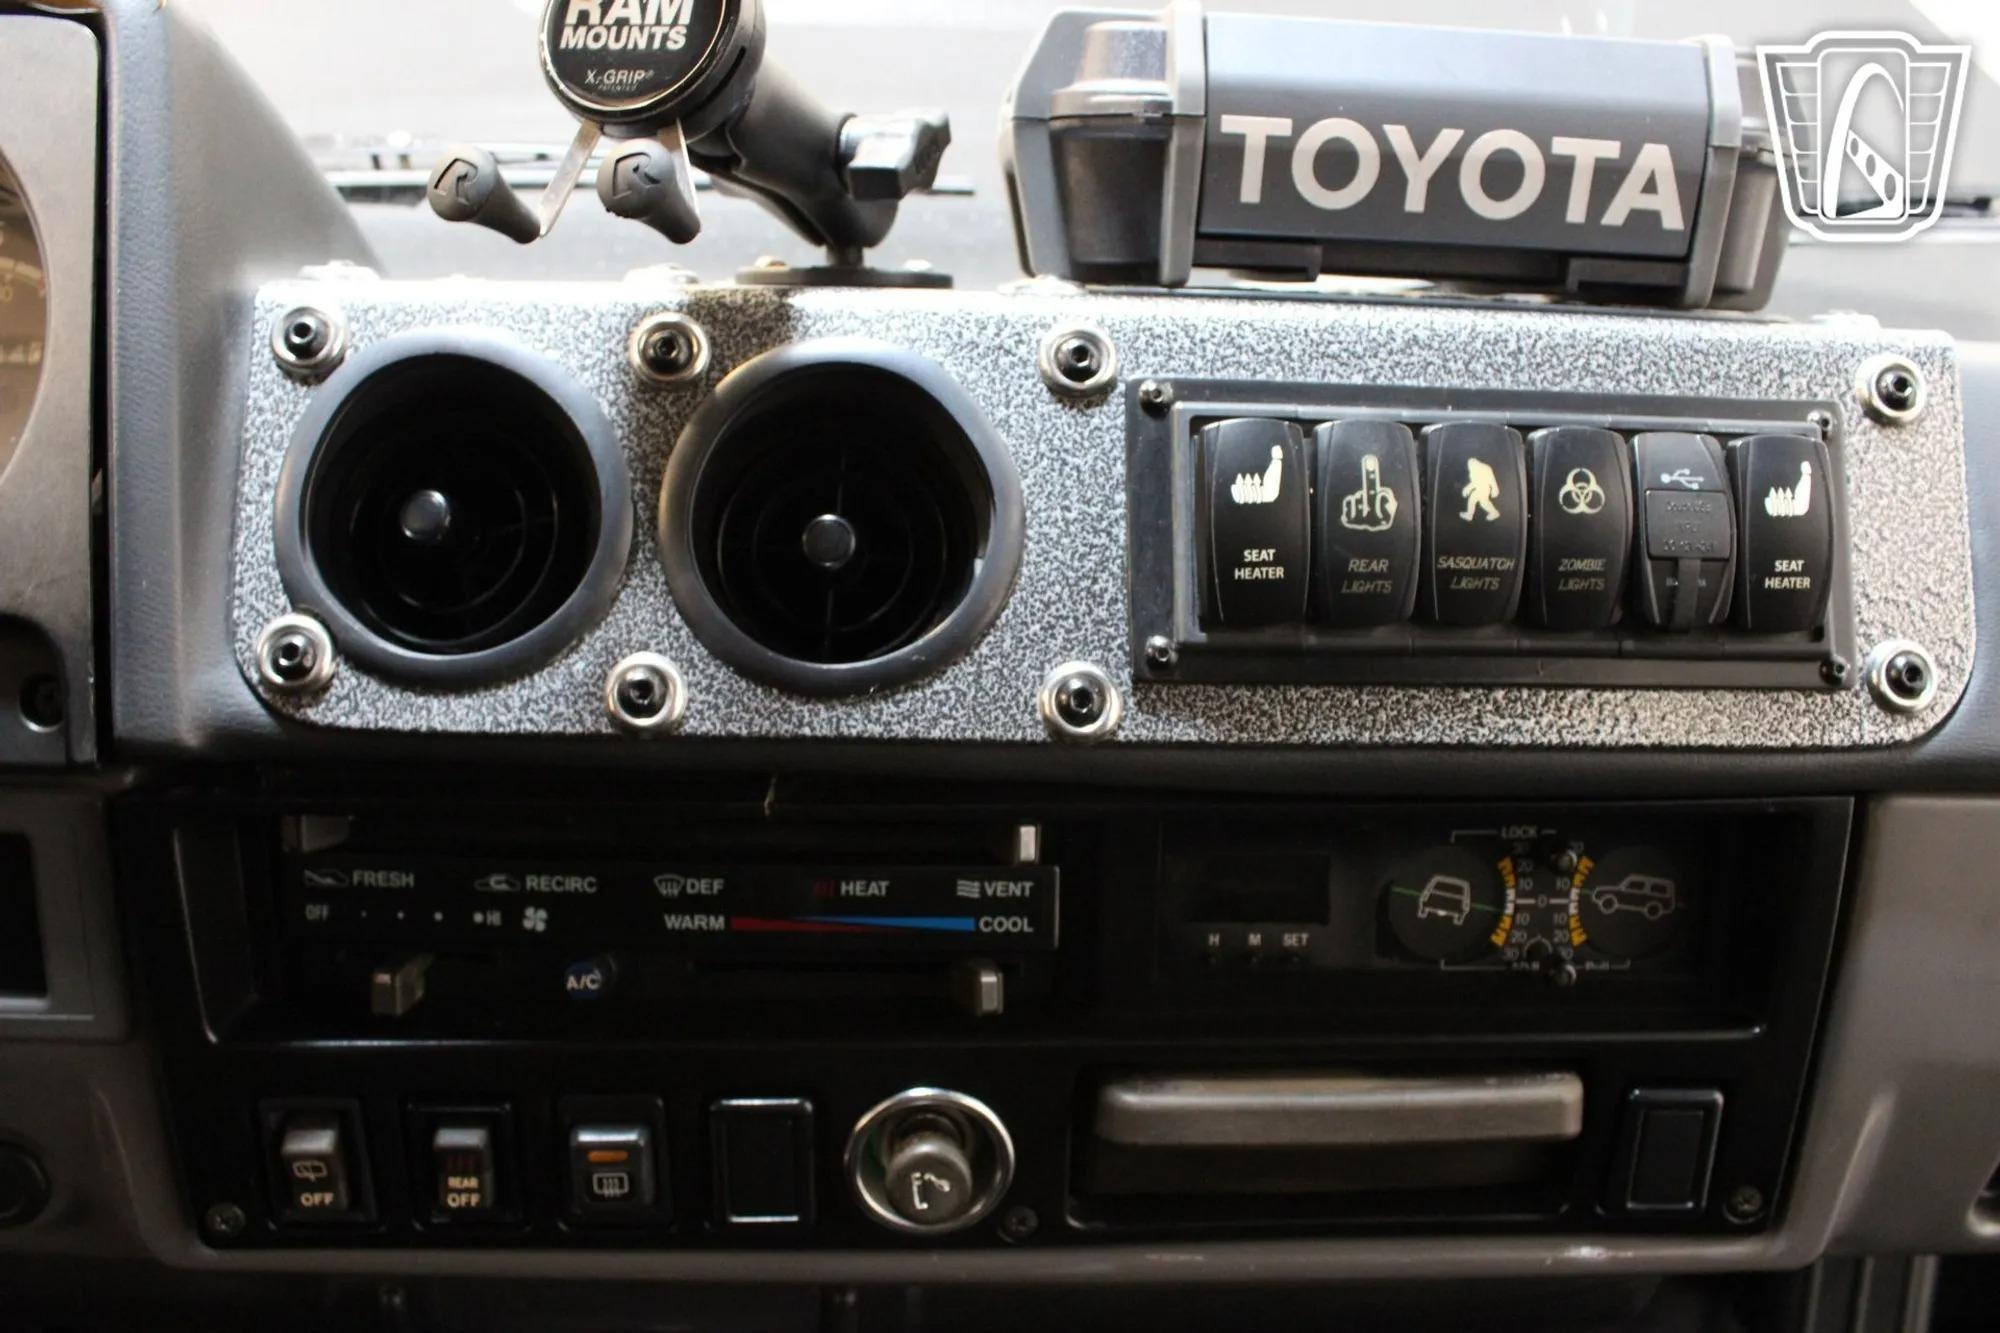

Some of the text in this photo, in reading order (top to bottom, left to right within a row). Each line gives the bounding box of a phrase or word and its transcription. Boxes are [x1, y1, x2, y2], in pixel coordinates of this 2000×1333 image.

[564, 0, 694, 25] RAM
[560, 25, 688, 50] MOUNTS
[1220, 114, 1685, 233] TOYOTA
[1243, 549, 1276, 562] SEAT
[1348, 558, 1389, 573] REAR
[1436, 556, 1516, 571] SASQUATCH
[1558, 558, 1607, 572] ZOMBIE
[1774, 560, 1805, 572] SEAT
[1234, 566, 1285, 580] HEATER
[1340, 580, 1393, 594] LIGHTS
[1450, 576, 1501, 591] LIGHTS
[1557, 577, 1606, 591] LIGHTS
[1764, 576, 1811, 589] HEATER
[1501, 825, 1538, 839] LOCK
[352, 869, 415, 888] FRESH
[525, 874, 598, 894] RECIRC
[1519, 877, 1533, 890] 10
[1556, 877, 1570, 890] 10
[686, 878, 725, 895] DEF
[840, 880, 890, 897] HEAT
[984, 880, 1034, 897] VENT
[305, 903, 330, 921] OFF
[1515, 913, 1530, 926] 10
[1554, 913, 1568, 925] 10
[664, 914, 725, 931] WARM
[979, 916, 1034, 933] COOL
[1208, 932, 1220, 947] H
[1248, 932, 1262, 947] M
[1282, 932, 1309, 947] SET
[1511, 929, 1527, 943] 20
[1554, 929, 1569, 943] 20
[566, 973, 601, 990] A/C
[447, 1176, 479, 1189] REAR
[300, 1192, 334, 1208] OFF
[447, 1192, 480, 1208] OFF
